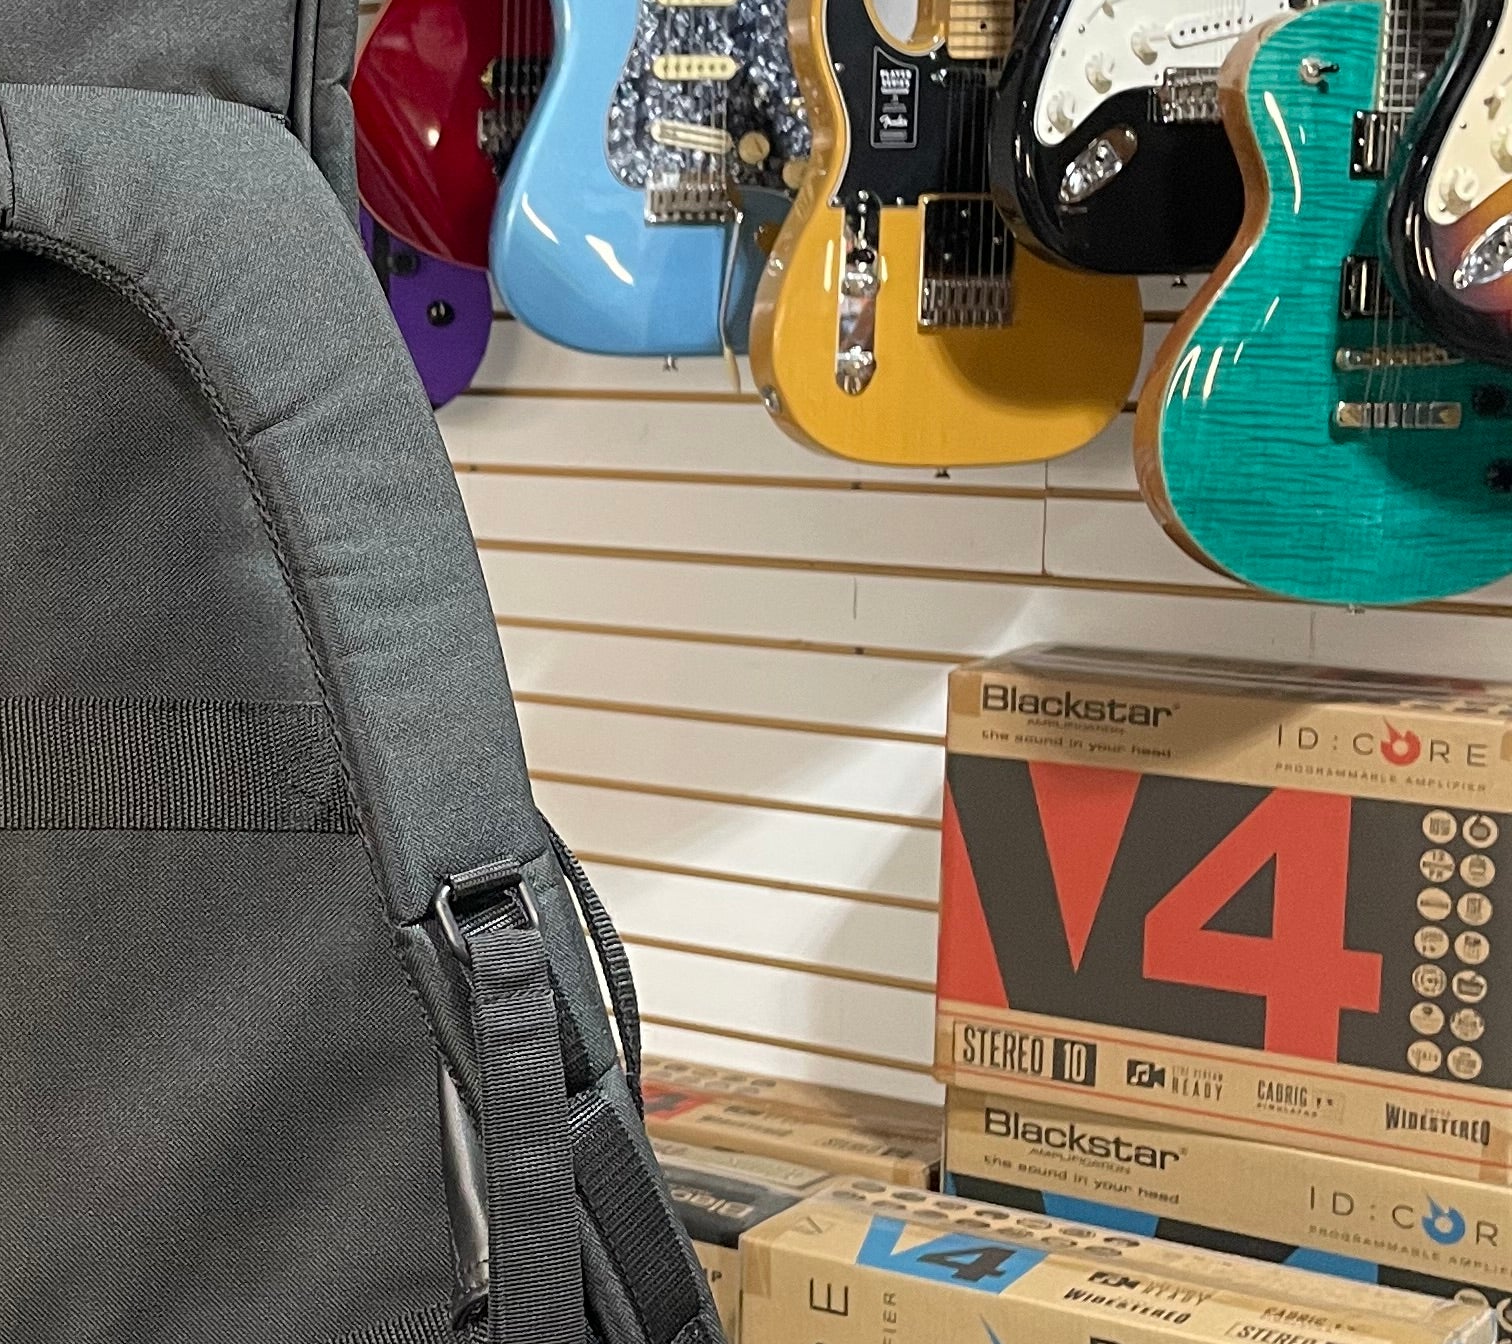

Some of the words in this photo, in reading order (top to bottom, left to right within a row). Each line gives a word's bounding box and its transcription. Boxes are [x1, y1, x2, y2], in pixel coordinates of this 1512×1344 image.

[982, 683, 1173, 728] Blackstar
[962, 1024, 1044, 1076] STEREO
[1064, 1041, 1088, 1083] 10
[1171, 1076, 1224, 1102] READY
[984, 1106, 1180, 1170] Blackstar
[1385, 1102, 1491, 1147] WIDESTEREO
[1018, 1164, 1068, 1183] sound
[1310, 1185, 1499, 1247] ID:COR
